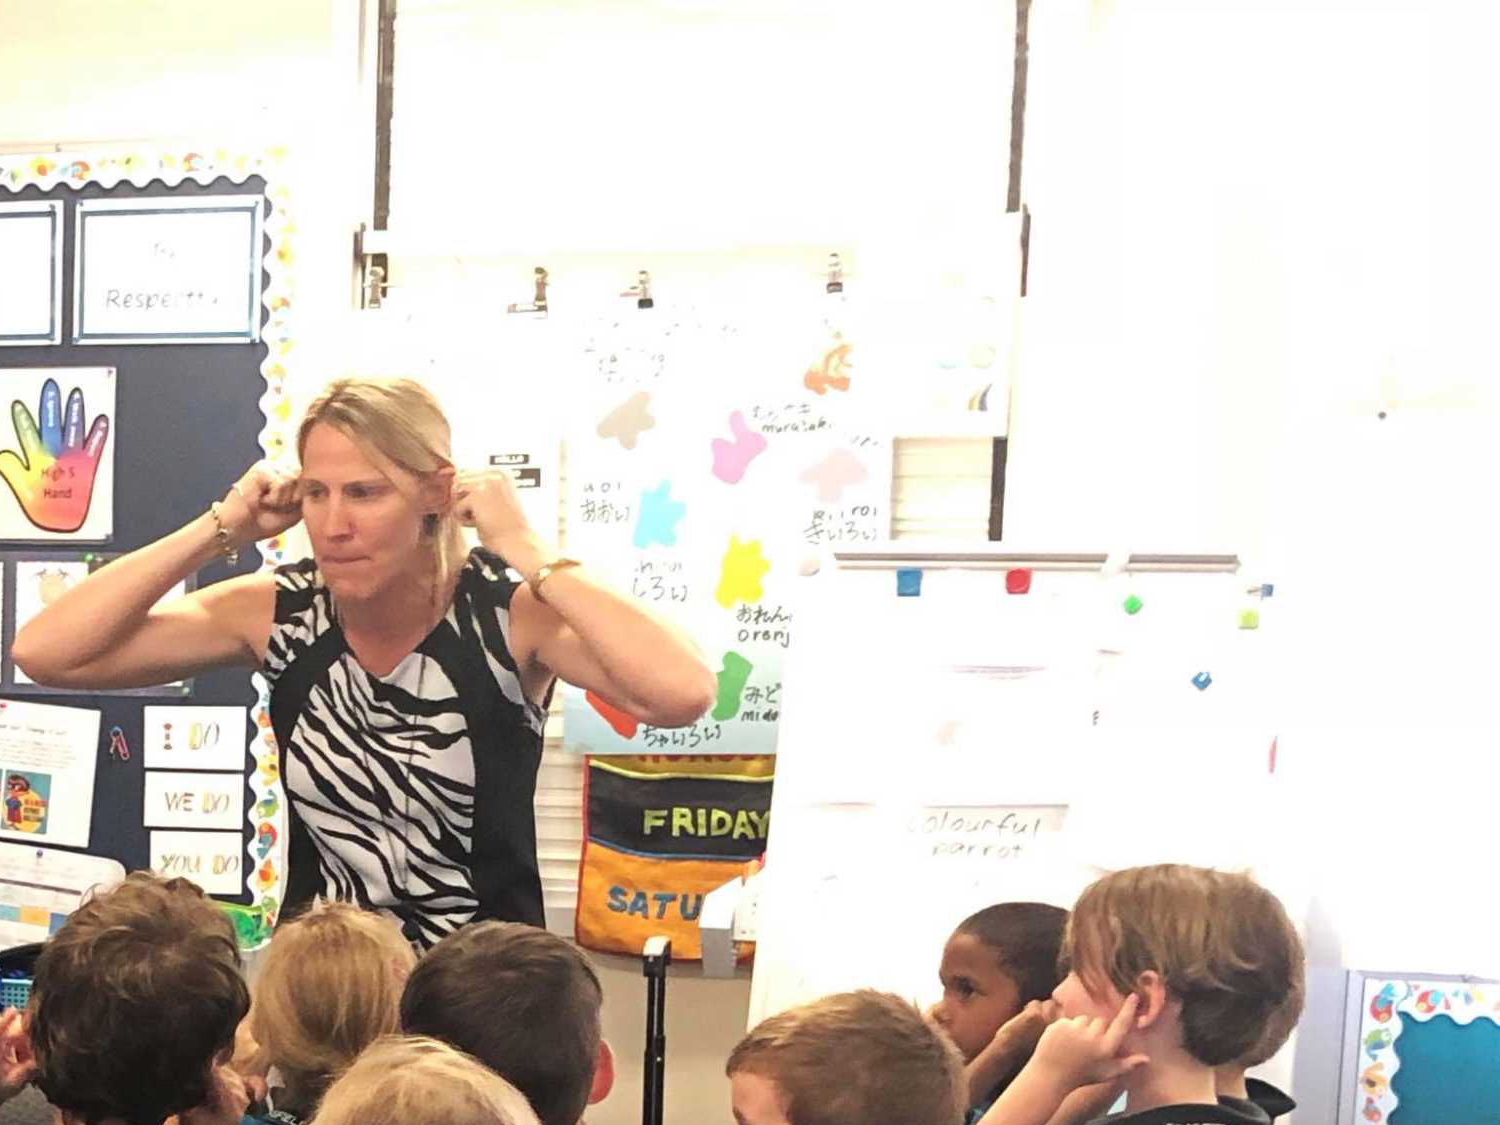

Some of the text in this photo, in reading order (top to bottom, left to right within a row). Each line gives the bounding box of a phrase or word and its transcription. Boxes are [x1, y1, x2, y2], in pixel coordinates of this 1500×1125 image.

[44, 487, 72, 499] Hand
[188, 722, 221, 751] DO
[164, 791, 231, 814] WE DO
[643, 806, 772, 841] FRIDAY
[160, 853, 240, 876] YOU DO
